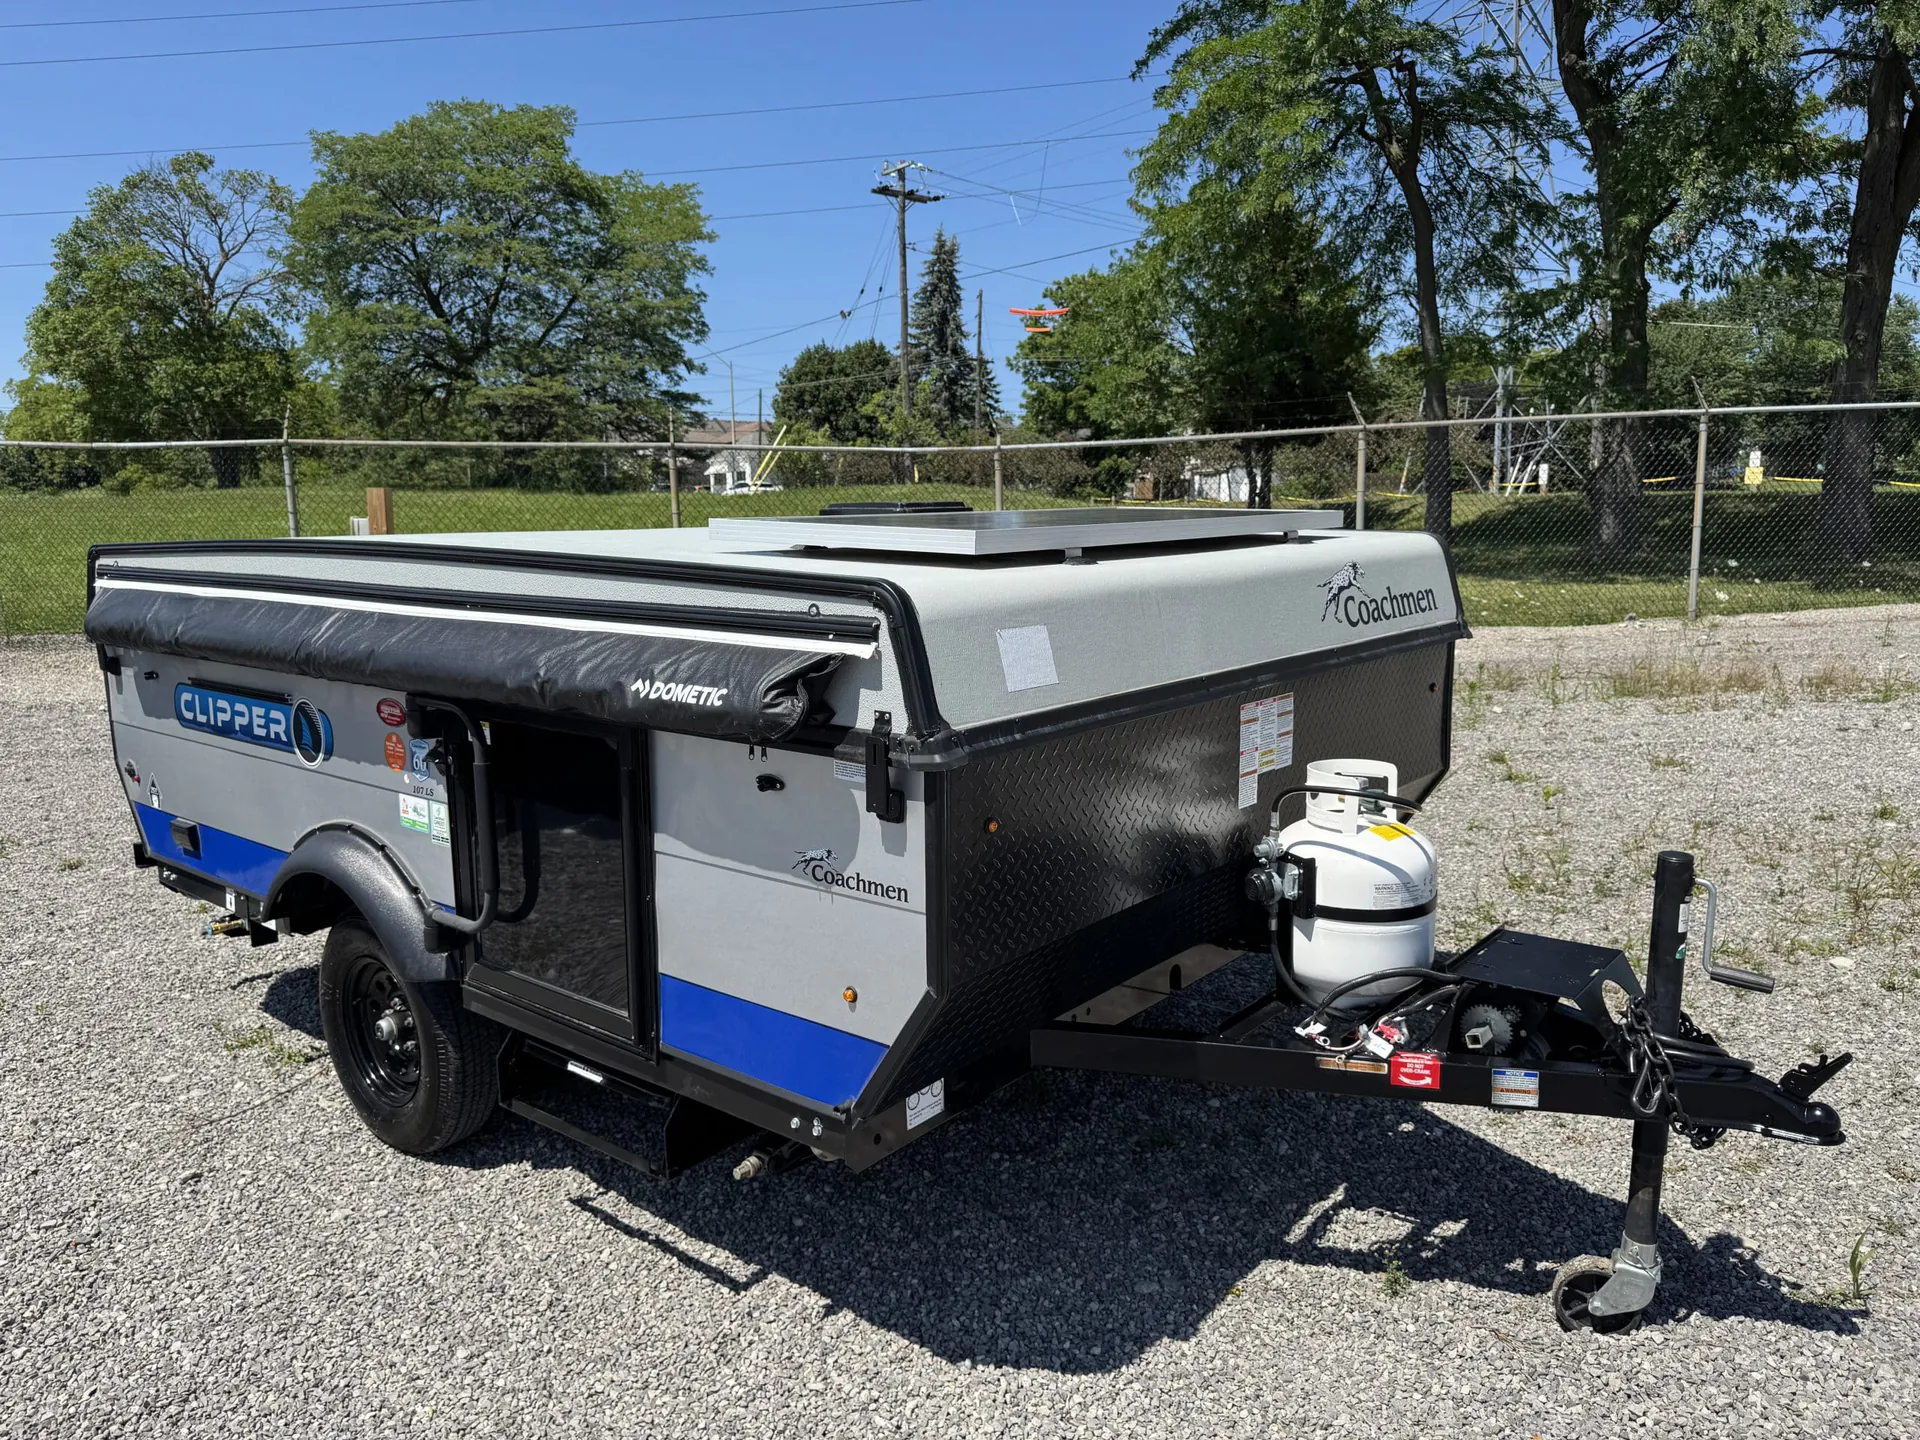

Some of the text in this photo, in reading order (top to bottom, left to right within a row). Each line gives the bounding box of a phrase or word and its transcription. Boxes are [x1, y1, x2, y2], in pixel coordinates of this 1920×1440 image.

[1344, 586, 1438, 628] Coachmen
[648, 680, 729, 706] DOMETIC
[180, 692, 288, 742] CLIPPER
[413, 785, 435, 797] 107 LS
[811, 864, 909, 903] Coachmen
